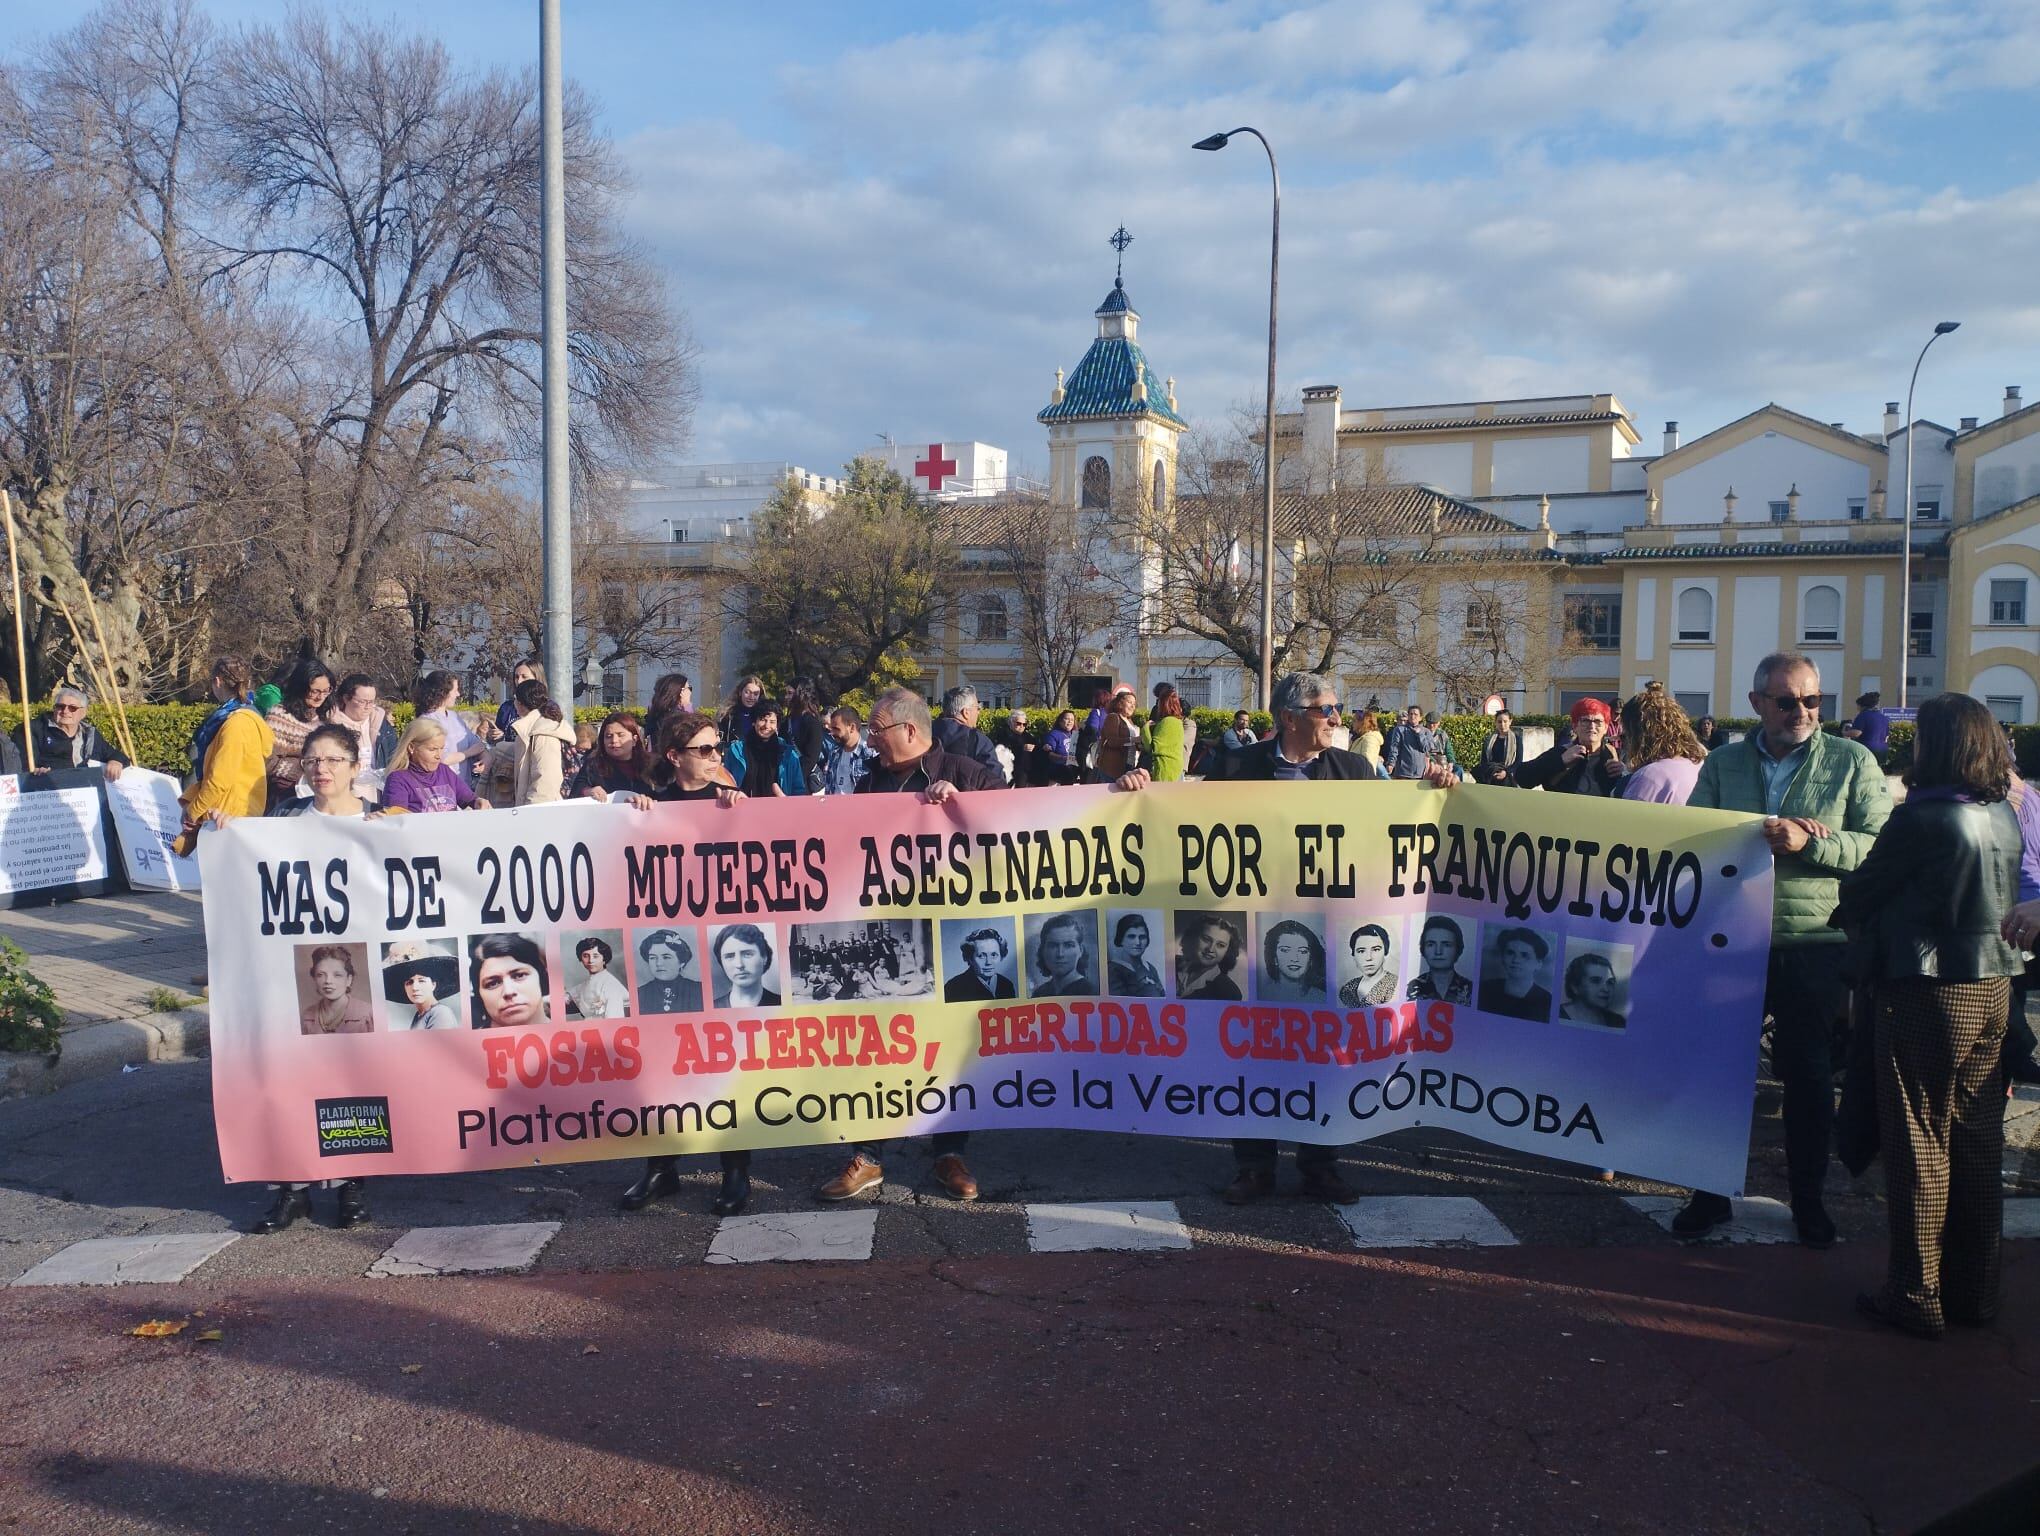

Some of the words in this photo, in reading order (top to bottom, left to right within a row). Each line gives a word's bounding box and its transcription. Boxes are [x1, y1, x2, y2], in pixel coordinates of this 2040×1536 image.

[13, 858, 41, 868] salarios
[42, 855, 53, 863] los
[43, 867, 49, 875] el
[24, 878, 50, 888] unidad
[258, 857, 350, 935] MAS
[384, 856, 446, 931] DE
[476, 841, 595, 924] 2000
[624, 838, 829, 919] MUJERES
[859, 823, 1146, 908] ASESINADAS
[1177, 823, 1268, 898] POR
[1295, 824, 1356, 899] EL
[482, 1026, 642, 1090] FOSAS
[673, 1014, 941, 1073] ABIERTAS,
[978, 1002, 1188, 1057] HERIDAS
[1218, 1001, 1455, 1066] CERRADAS
[458, 1100, 738, 1150] Plataforma
[754, 1075, 976, 1127] Comisión
[992, 1070, 1057, 1109] de
[1072, 1069, 1113, 1110] la
[1128, 1073, 1332, 1127] Verdad,
[1348, 1060, 1605, 1145] CÓRDOBA
[319, 1105, 385, 1120] PLATAFORMA
[320, 1117, 355, 1129] COMISIÓN
[358, 1118, 368, 1126] DE
[368, 1118, 377, 1126] LA
[322, 1138, 388, 1150] CÓRDOBA
